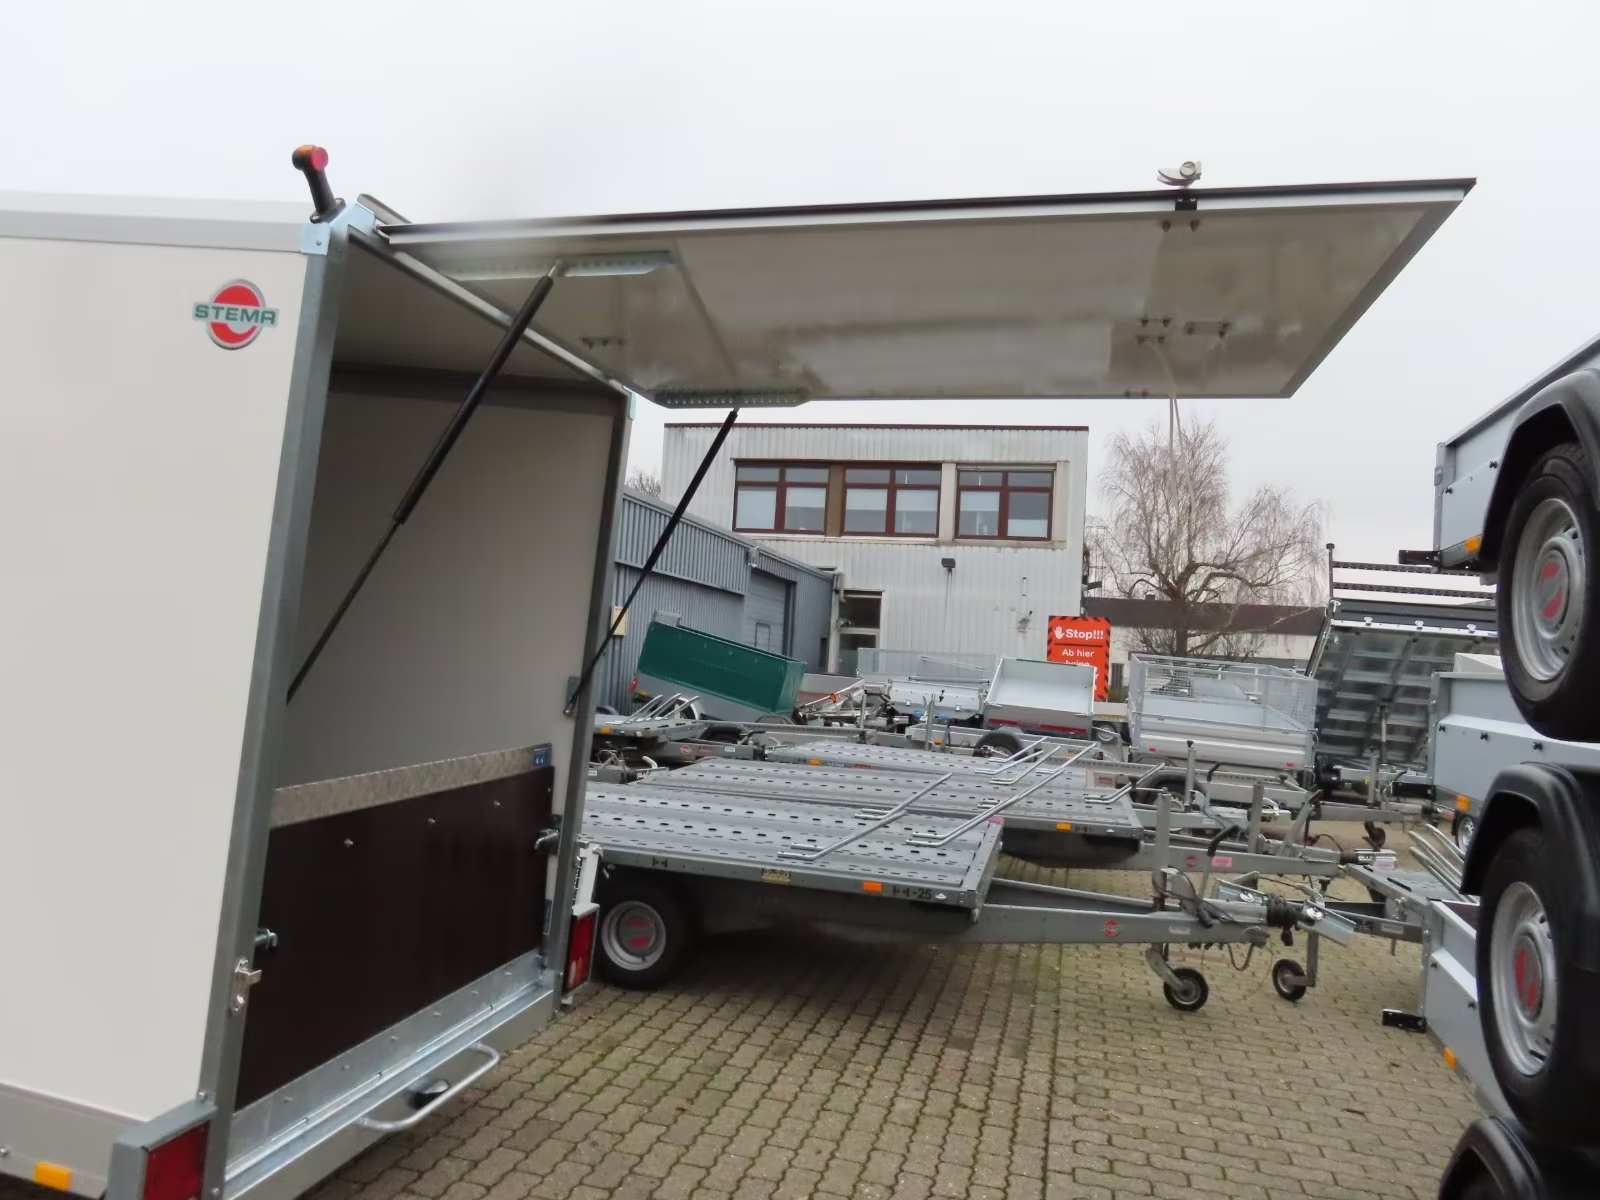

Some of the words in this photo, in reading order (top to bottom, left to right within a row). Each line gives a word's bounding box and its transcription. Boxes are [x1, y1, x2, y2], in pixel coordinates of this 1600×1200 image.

[194, 304, 277, 325] STEMA
[1065, 629, 1104, 640] Stop!!!
[1062, 648, 1075, 657] Ab
[1076, 649, 1095, 657] hier
